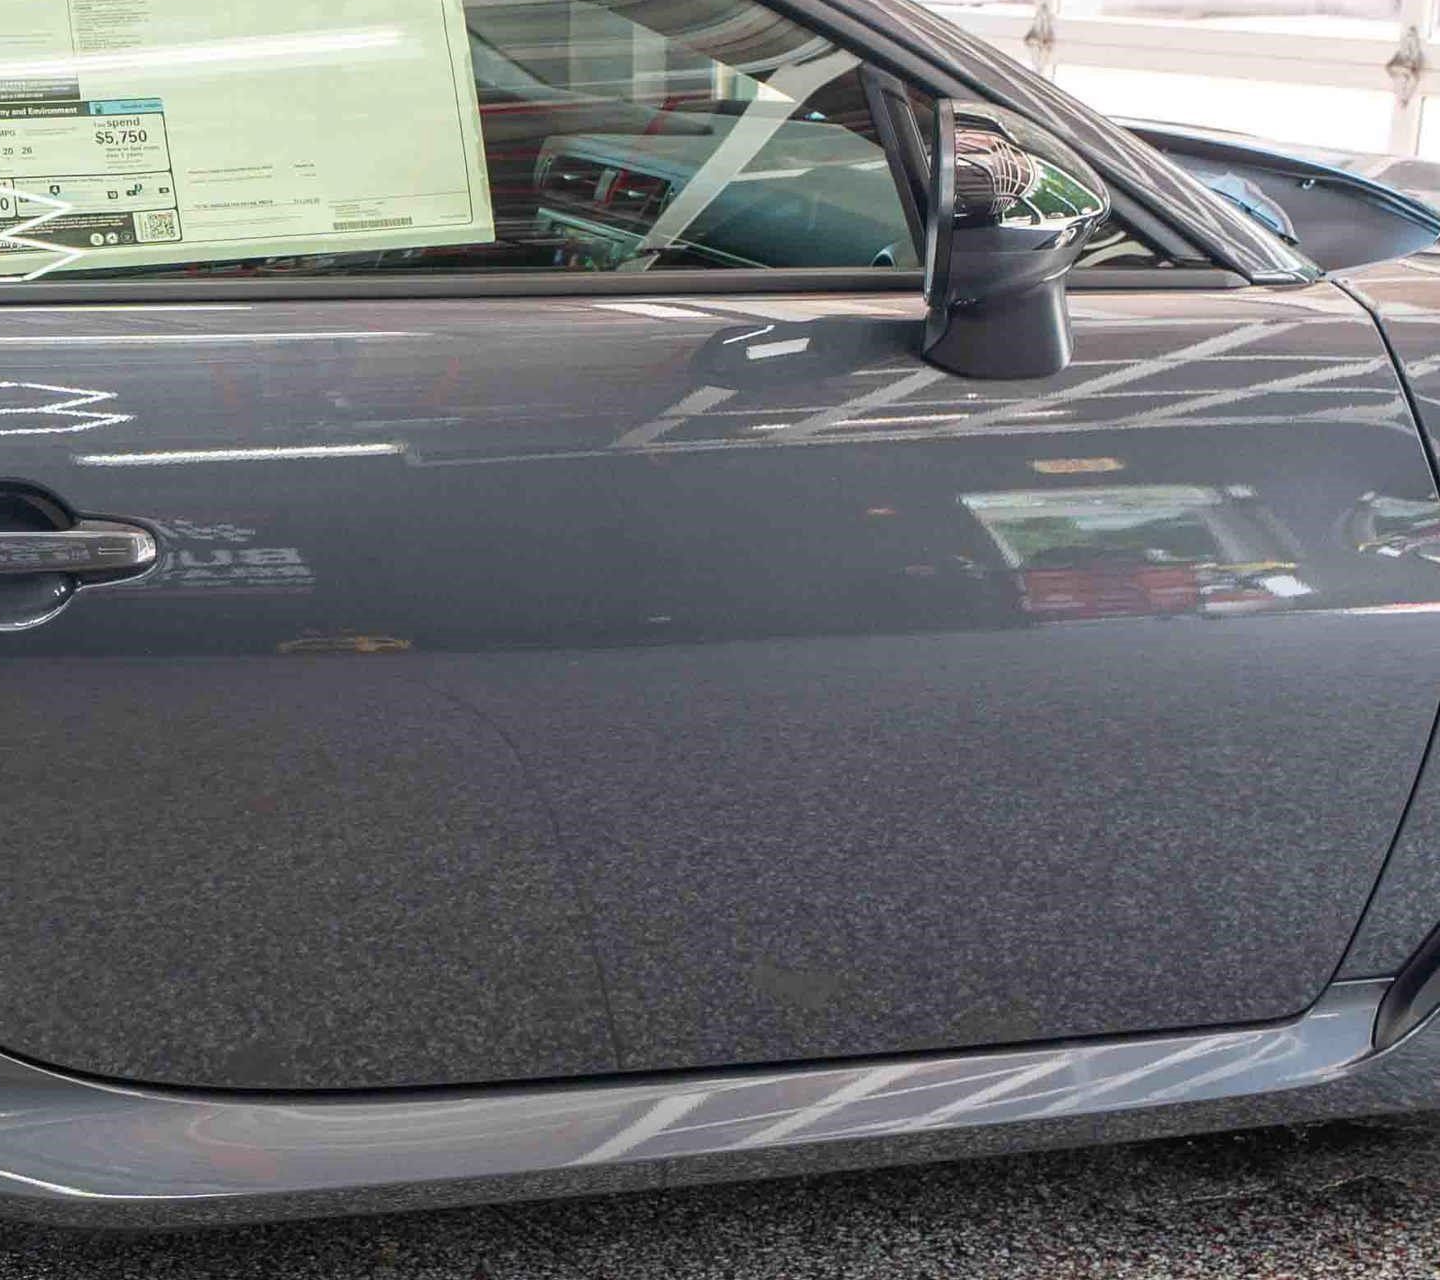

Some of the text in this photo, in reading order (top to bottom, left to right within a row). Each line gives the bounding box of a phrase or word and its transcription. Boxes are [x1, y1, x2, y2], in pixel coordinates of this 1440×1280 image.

[12, 106, 26, 115] and
[28, 105, 78, 115] Environment
[106, 117, 140, 128] spend
[95, 129, 147, 145] $5,750
